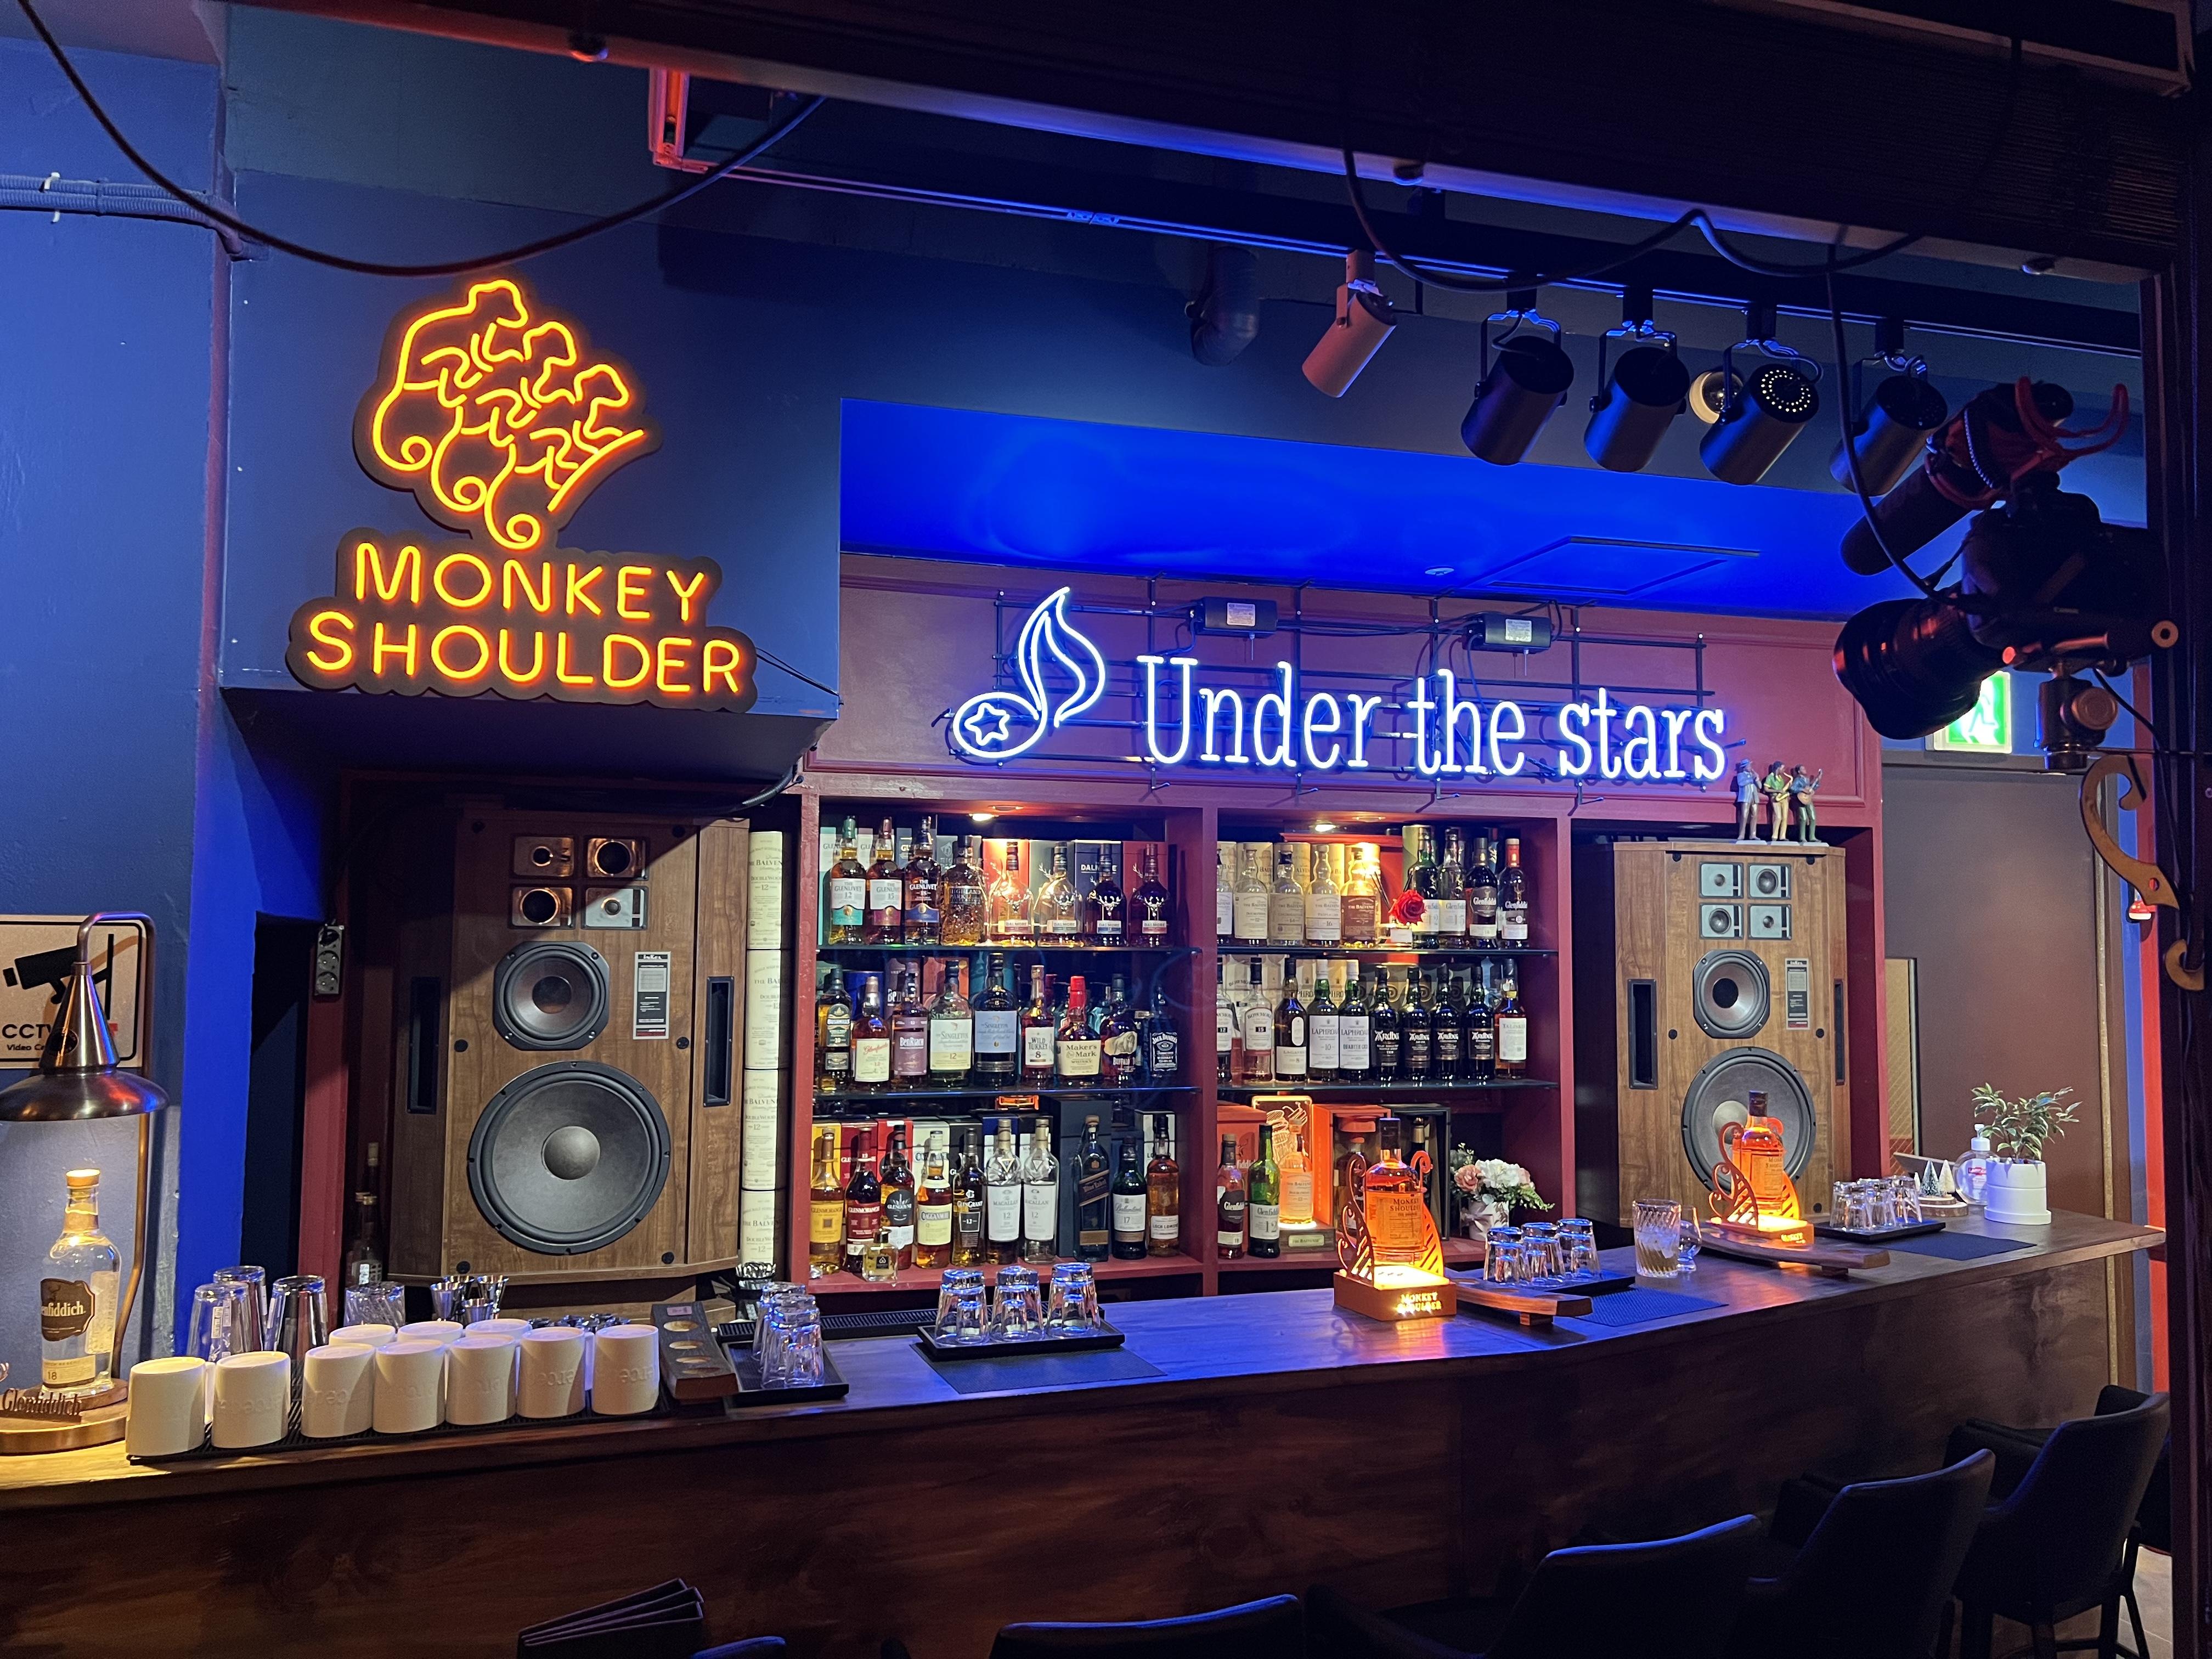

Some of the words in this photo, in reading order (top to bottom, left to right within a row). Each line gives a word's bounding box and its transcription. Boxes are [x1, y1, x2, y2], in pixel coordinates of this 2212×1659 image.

[355, 542, 704, 622] MONKEY
[307, 610, 740, 693] SHOULDER
[1136, 654, 1382, 766] Under
[1407, 668, 1527, 776] the
[1559, 687, 1726, 782] stars
[1028, 1042, 1048, 1050] TURKEY
[1265, 1221, 1278, 1233] 12
[1401, 1291, 1438, 1303] MONKEY
[48, 1372, 57, 1380] 18
[3, 1388, 82, 1415] Glenfiddich
